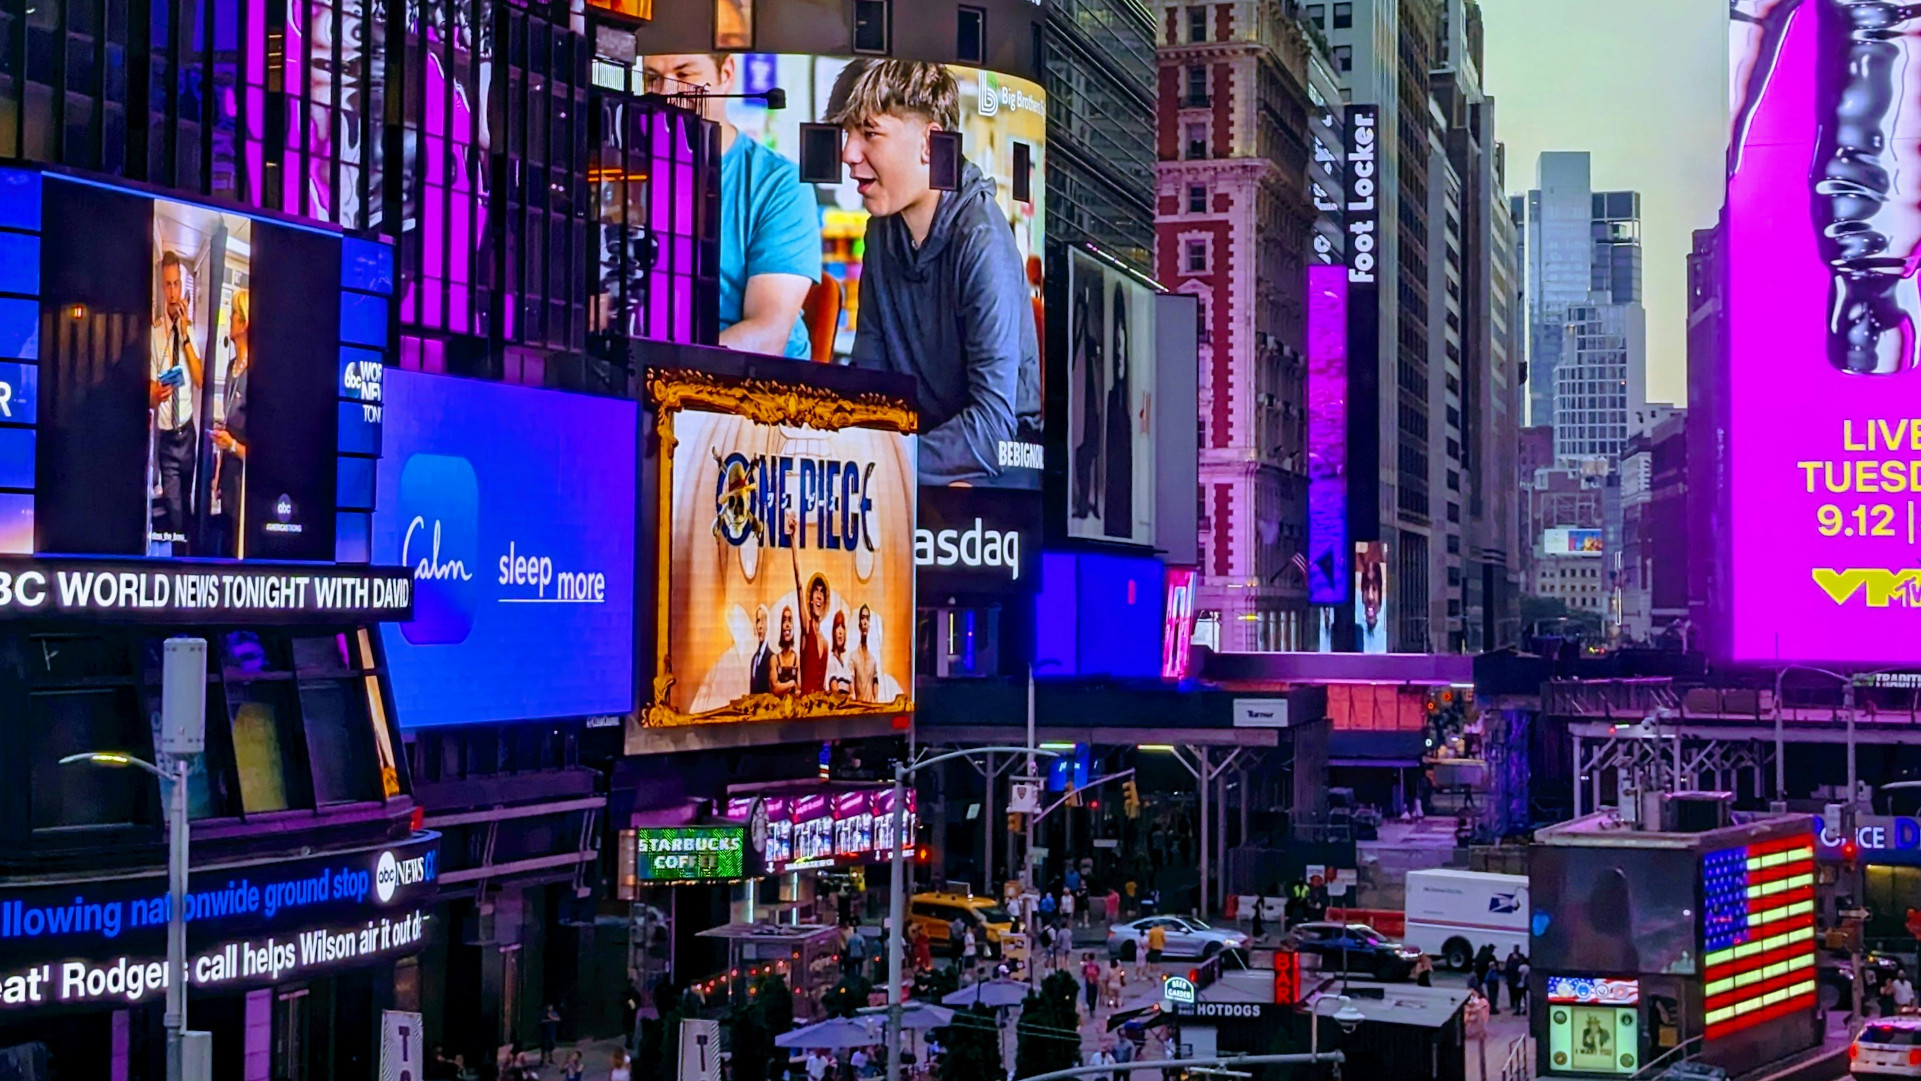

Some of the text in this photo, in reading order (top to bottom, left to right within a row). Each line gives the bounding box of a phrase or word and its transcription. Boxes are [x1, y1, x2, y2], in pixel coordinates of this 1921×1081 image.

[1001, 86, 1016, 111] Big
[1348, 220, 1374, 283] Foot
[715, 451, 876, 552] ONE PIECE
[1816, 503, 1895, 537] 9.12
[402, 515, 473, 581] Calm
[498, 541, 605, 600] sleep more
[57, 571, 171, 607] WORLD
[174, 574, 219, 608] NEWS
[222, 575, 310, 608] TONIGHT
[314, 577, 369, 608] WITH
[372, 578, 409, 608] DAVID
[638, 837, 740, 852] STARBUCKS
[2, 896, 122, 938] llowing
[131, 879, 260, 927] natonwide
[264, 868, 330, 917] ground
[333, 867, 369, 902] stop
[378, 866, 395, 884] abc
[396, 857, 424, 886] NEWS
[196, 943, 237, 983] call
[243, 938, 296, 979] helps
[300, 929, 356, 965] Wilson
[360, 920, 379, 955] air
[381, 918, 391, 950] it
[392, 914, 411, 947] out
[1276, 951, 1291, 1004] BAR
[1197, 1004, 1261, 1016] HOTDOGS
